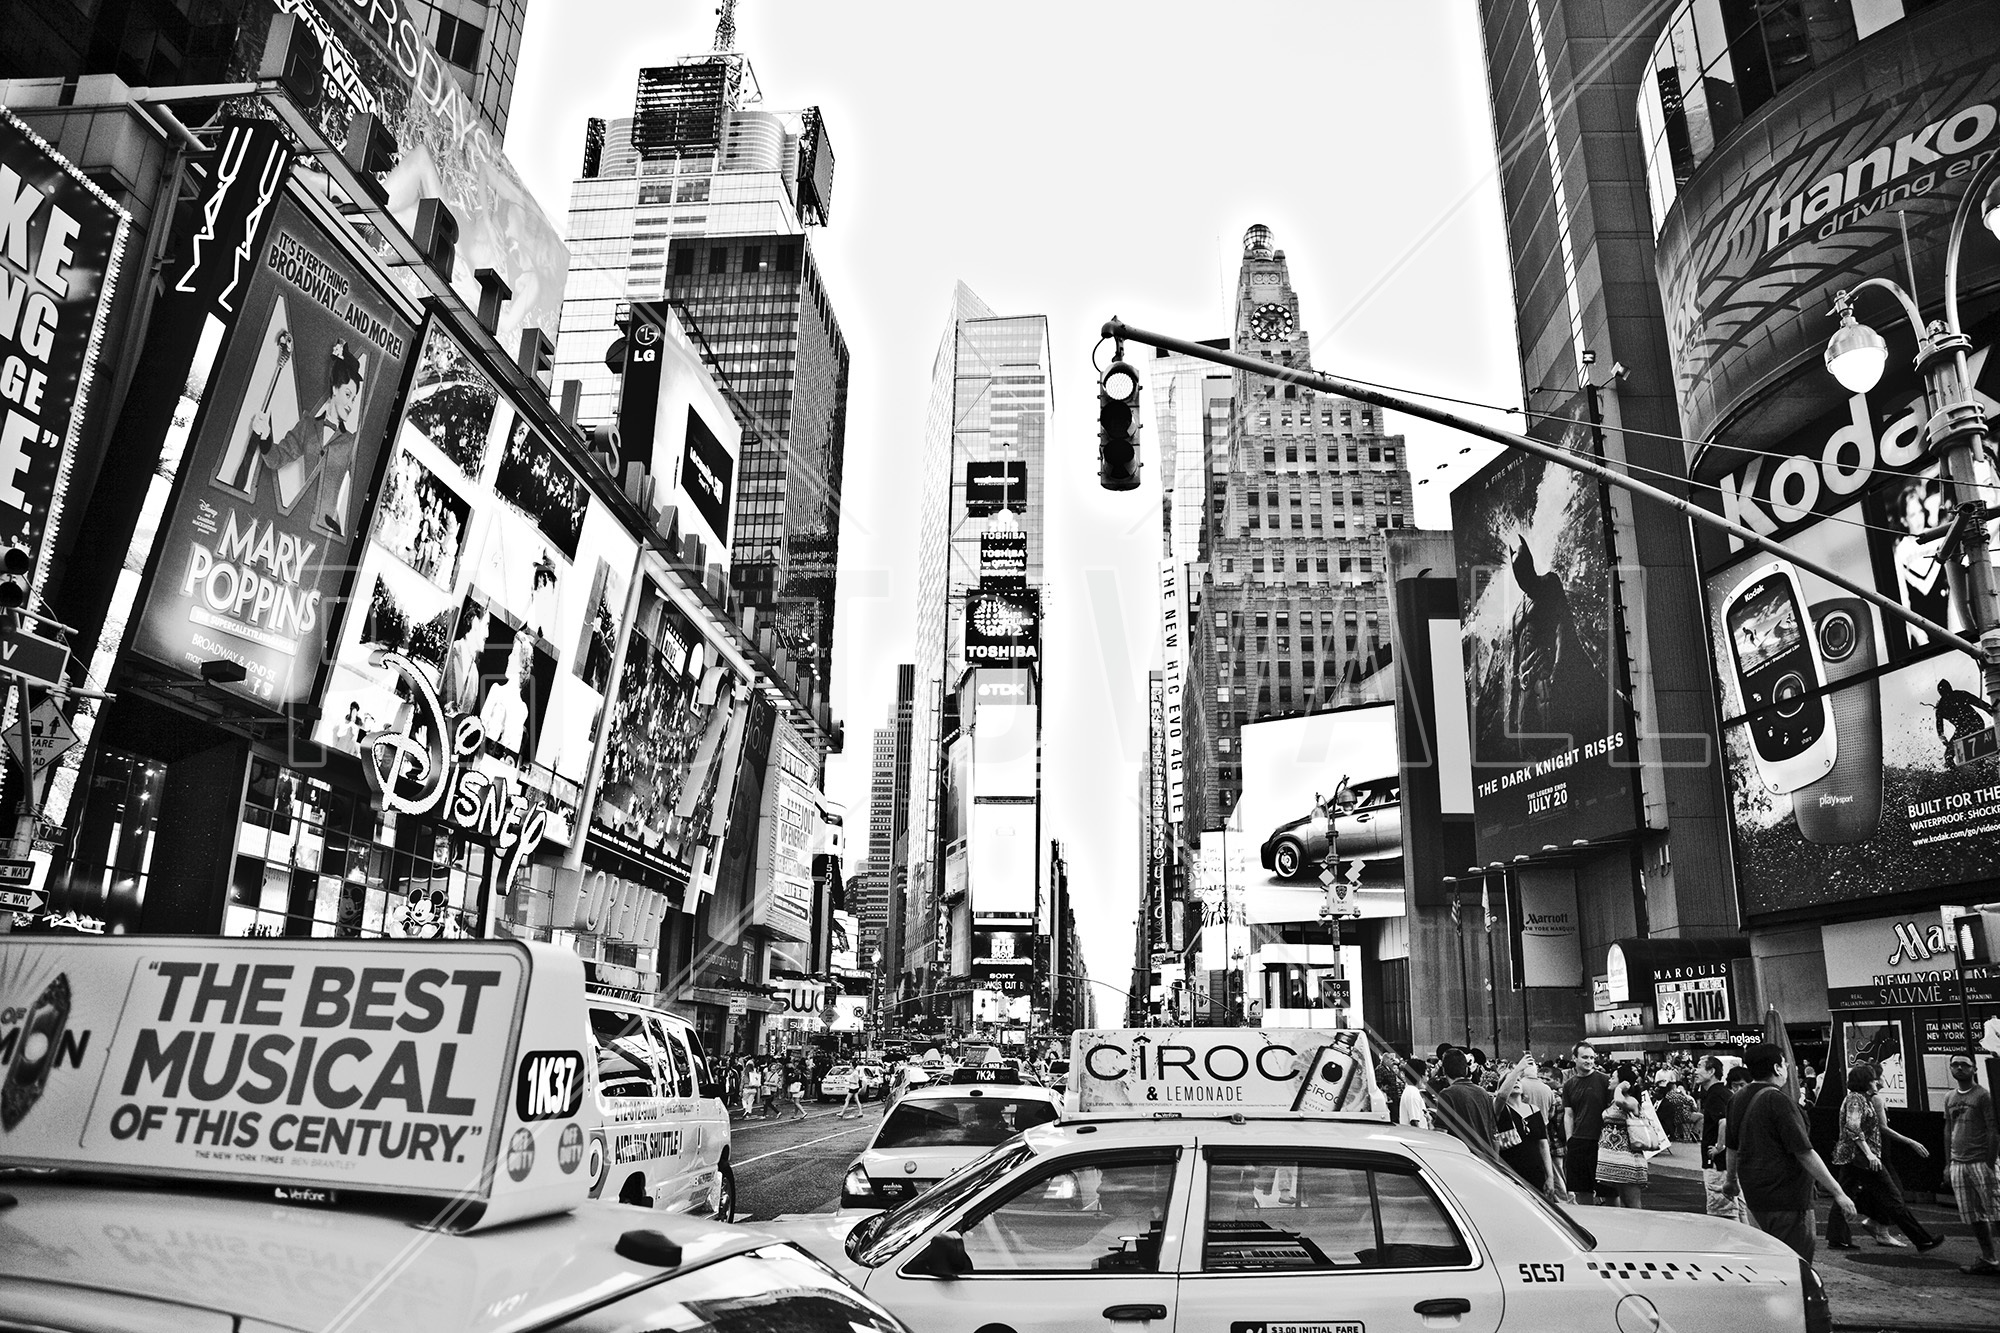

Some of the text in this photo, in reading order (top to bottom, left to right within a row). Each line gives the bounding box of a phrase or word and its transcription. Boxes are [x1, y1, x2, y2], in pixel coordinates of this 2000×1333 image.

[1818, 171, 1936, 241] driving
[297, 241, 349, 297] EVERYTHING
[344, 302, 369, 335] AND
[369, 321, 403, 361] MORE!
[633, 349, 656, 362] LG
[1490, 468, 1506, 486] FIRE
[1507, 457, 1523, 473] WILL
[217, 508, 317, 585] MARY
[982, 549, 1025, 557] TOSHIBA
[179, 541, 322, 636] POPPINS
[1163, 567, 1175, 600] THE
[1744, 584, 1765, 601] Kodak
[1164, 608, 1178, 648] NEW
[191, 633, 239, 663] BROADWAY
[966, 646, 1037, 657] TOSHIBA
[989, 684, 1025, 695] TDK
[1167, 660, 1180, 695] HTC
[1168, 704, 1183, 738] EVO
[1170, 748, 1183, 771] 4G
[1967, 737, 1977, 757] 7
[1478, 732, 1625, 798] THE DARK KNIGHT RISES
[1528, 794, 1551, 815] JULY
[1553, 789, 1568, 807] 20
[1907, 785, 2000, 818] BUILT FOR THE
[1910, 812, 1967, 831] WATERPROOF.
[10, 867, 29, 879] WAY
[12, 893, 31, 907] WAY
[1526, 913, 1568, 925] Marriott
[1653, 962, 1728, 980] MARQUIS
[299, 965, 502, 1035] BEST
[1684, 990, 1726, 1022] EVITA
[1926, 1022, 1951, 1031] ITALAN
[120, 1028, 479, 1117] MUSICAL
[976, 1070, 996, 1081] 7K24
[528, 1057, 578, 1116] 1K37
[1146, 1086, 1243, 1101] & LEMONADE
[109, 1102, 168, 1142] OF
[175, 1107, 262, 1149] THIS
[195, 1150, 210, 1159] THE
[212, 1152, 231, 1160] NEW
[235, 1153, 257, 1162] YORK
[260, 1155, 285, 1165] TIMES
[311, 1158, 357, 1170] BRANTLEY
[615, 1130, 679, 1165] AIRLINK SHUTTLE
[1518, 1263, 1565, 1283] 5C57
[1299, 1325, 1331, 1333] INITIAL
[1335, 1325, 1360, 1333] FARE
